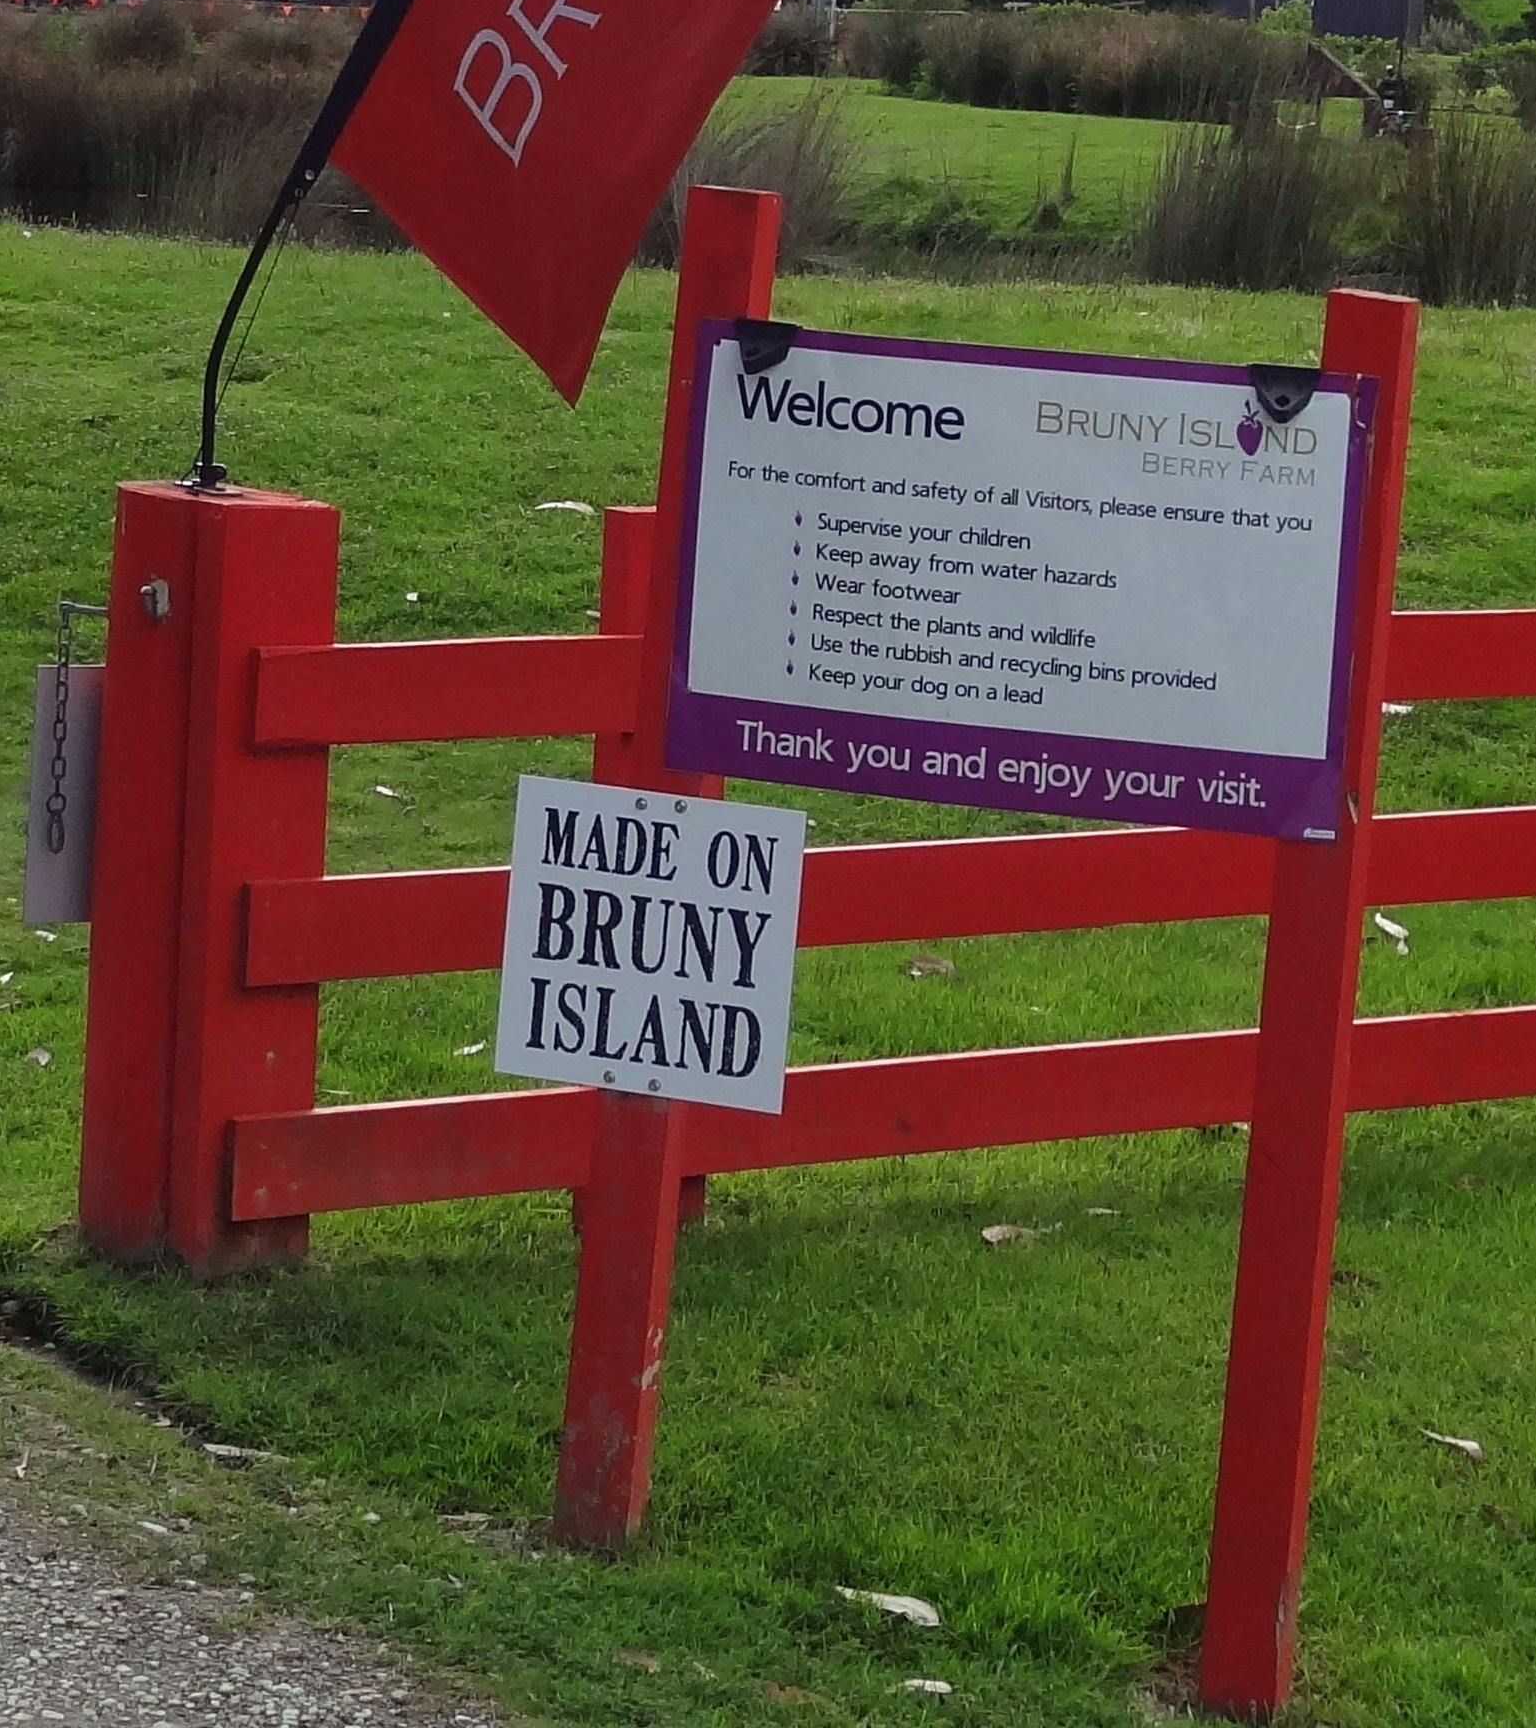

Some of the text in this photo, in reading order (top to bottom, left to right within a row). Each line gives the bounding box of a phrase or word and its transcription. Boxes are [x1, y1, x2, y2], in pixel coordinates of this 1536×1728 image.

[737, 373, 965, 440] Welcome
[1035, 400, 1318, 456] BRUNY ISLND
[728, 461, 1312, 533] For the comfort and safety of all Visitors, please ensure that you
[1142, 452, 1316, 487] BERRY FARM
[817, 512, 1032, 550] Supervise your children
[815, 543, 1118, 589] Keep away from water hazards
[815, 572, 962, 604] Wear footwear
[812, 603, 1096, 649] Respect the plants and wildlife
[809, 663, 1043, 705] Keep your dog on a lead
[811, 633, 1217, 691] Use the rubbish and recycling bins provided
[735, 719, 1267, 808] Thank you and enjoy your visit.
[541, 807, 779, 895] MADE ON
[532, 882, 772, 989] BRUNY
[525, 977, 762, 1078] ISLAND
